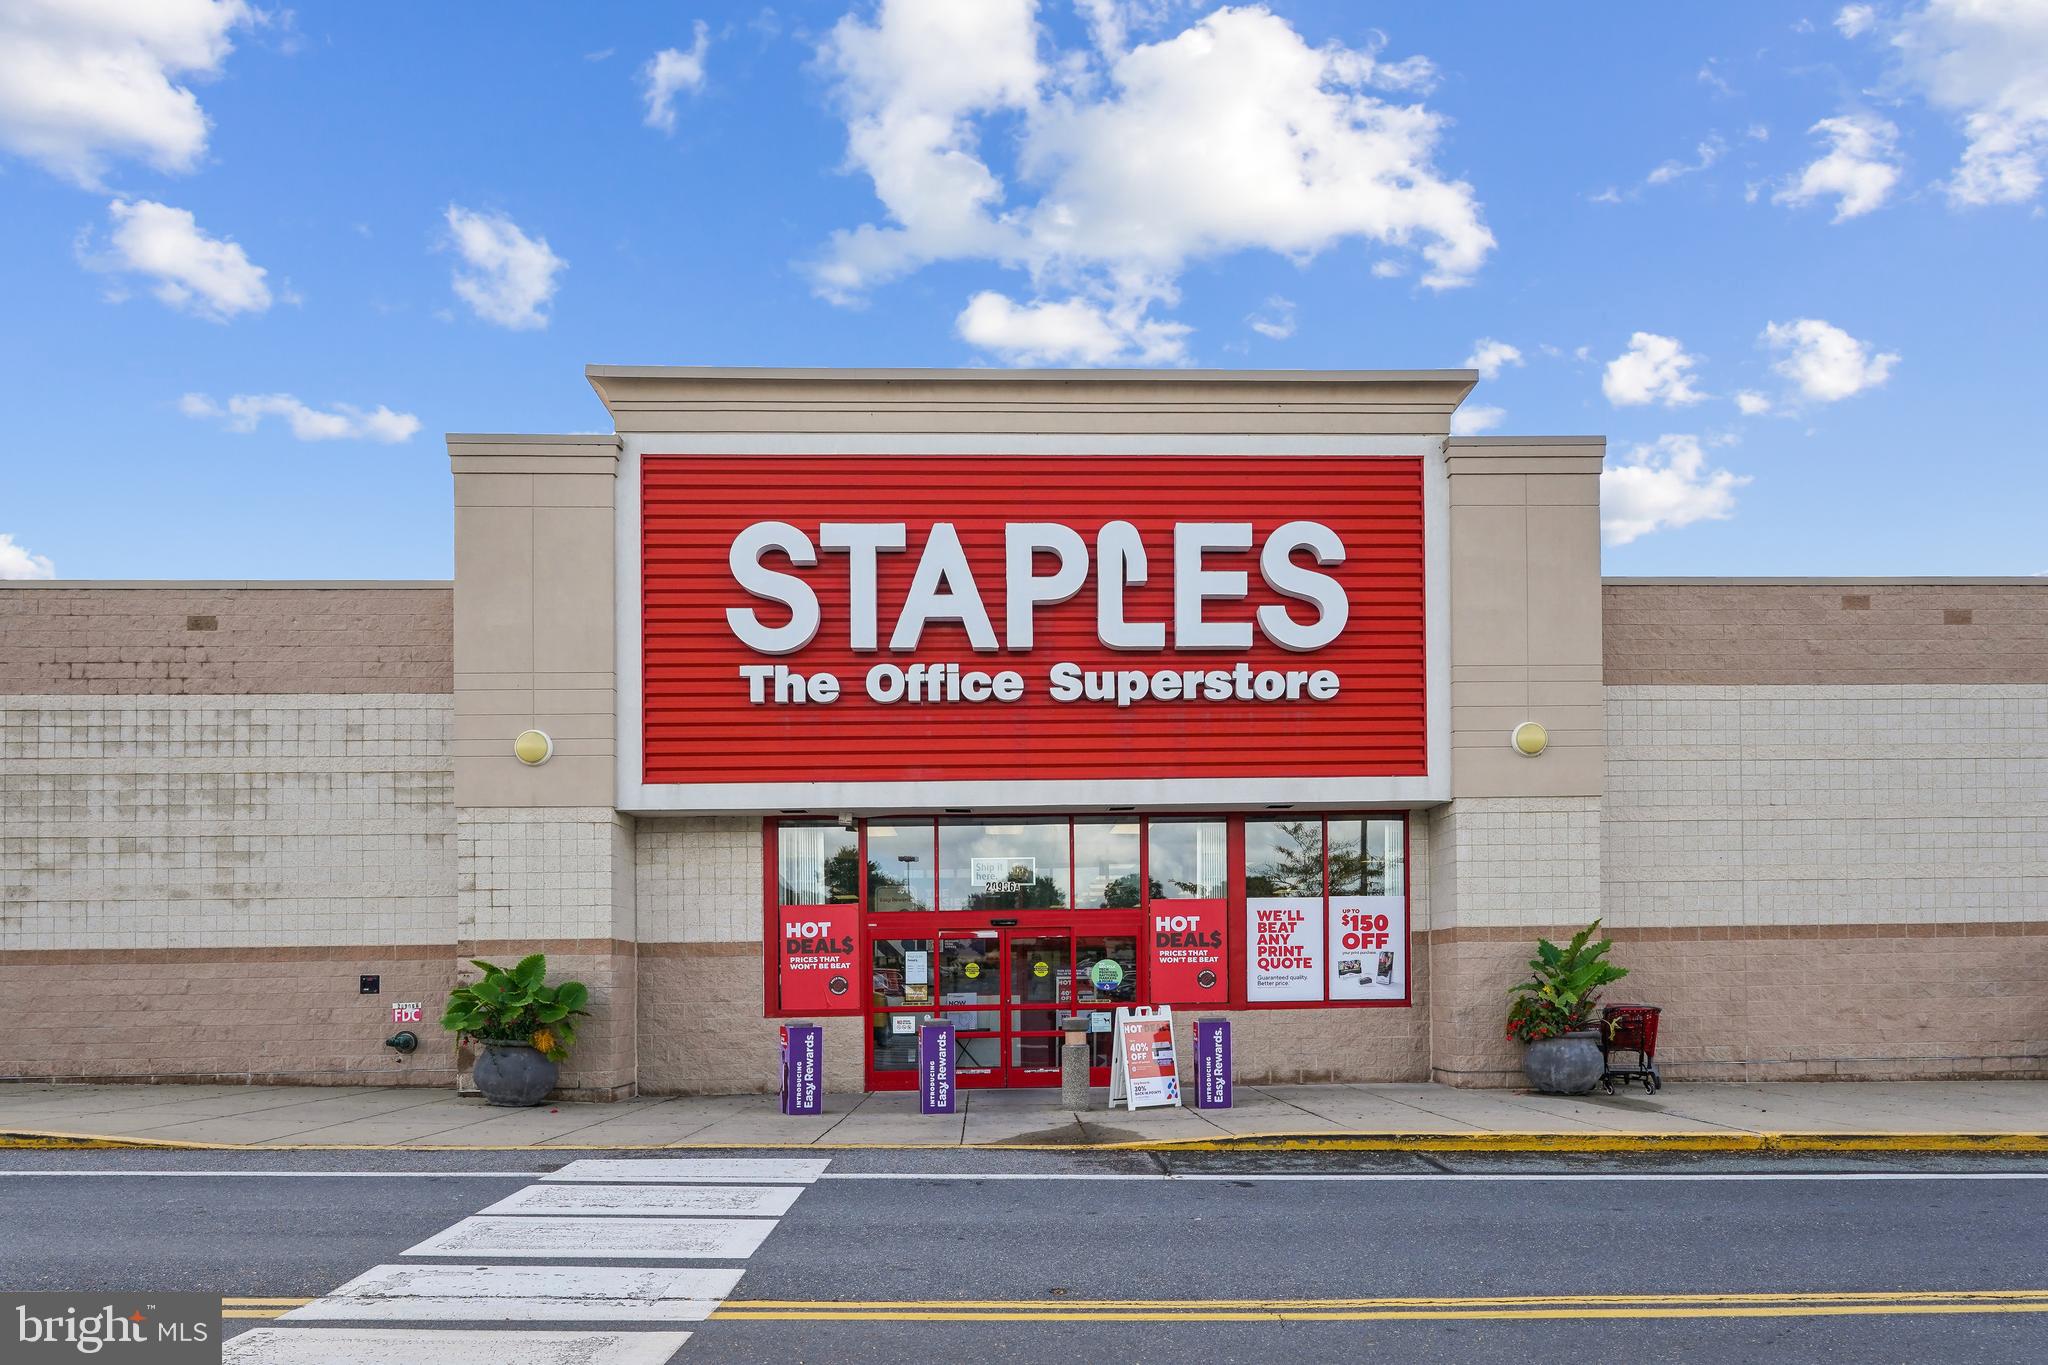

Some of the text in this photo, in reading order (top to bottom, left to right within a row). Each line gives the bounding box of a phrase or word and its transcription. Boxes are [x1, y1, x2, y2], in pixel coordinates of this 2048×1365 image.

[725, 519, 1349, 655] STAPLES
[740, 662, 1340, 706] The Office Superstore
[976, 863, 995, 873] Ship
[976, 872, 998, 880] here.
[1257, 910, 1304, 921] WE'LL
[1341, 914, 1389, 931] $150
[786, 922, 831, 938] HOT
[1155, 916, 1200, 932] HOT
[1257, 922, 1297, 933] BEAT
[786, 936, 854, 955] DEAL$
[1156, 930, 1222, 949] DEAL$
[1257, 934, 1291, 945] ANY
[1342, 932, 1389, 950] OFF
[1257, 945, 1304, 957] PRINT
[1257, 957, 1312, 972] QUOTE
[394, 1009, 420, 1022] FDC
[1124, 1024, 1142, 1034] HOT
[1130, 1042, 1148, 1052] 40%
[1131, 1052, 1147, 1061] OFF
[804, 1032, 816, 1109] Easy Rewards.
[937, 1031, 949, 1107] Easy Rewards.
[1213, 1027, 1225, 1103] Easy Rewards.
